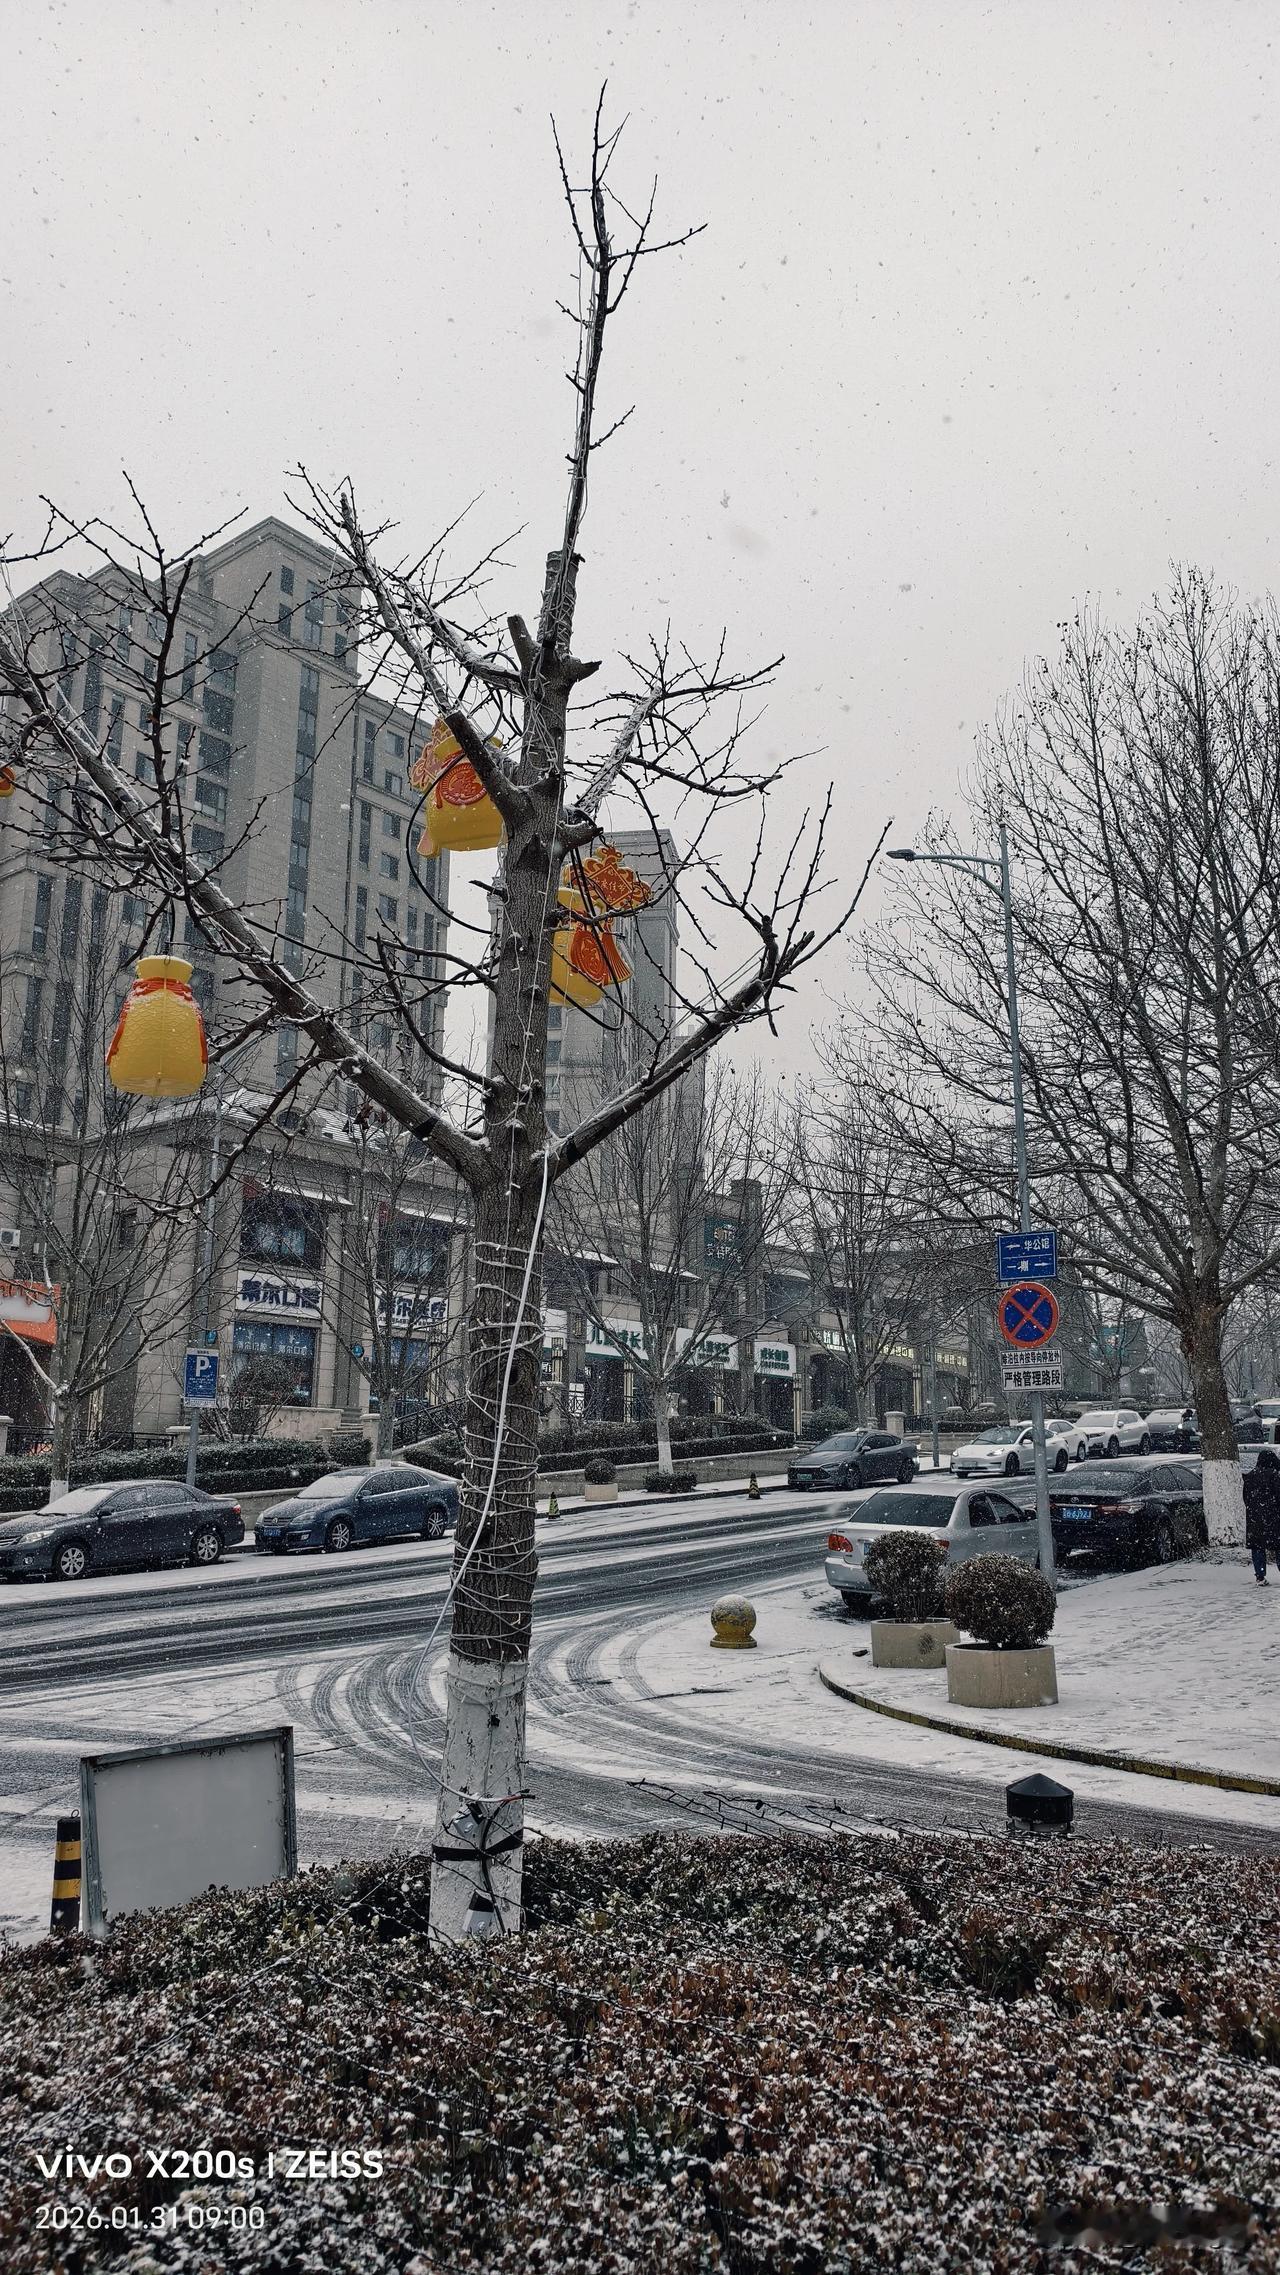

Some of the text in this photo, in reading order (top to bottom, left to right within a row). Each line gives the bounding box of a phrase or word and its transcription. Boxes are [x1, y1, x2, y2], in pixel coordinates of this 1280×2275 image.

[1024, 1237, 1050, 1251] 华公馆
[196, 1356, 210, 1377] P
[1004, 1369, 1061, 1388] 严格管理路段
